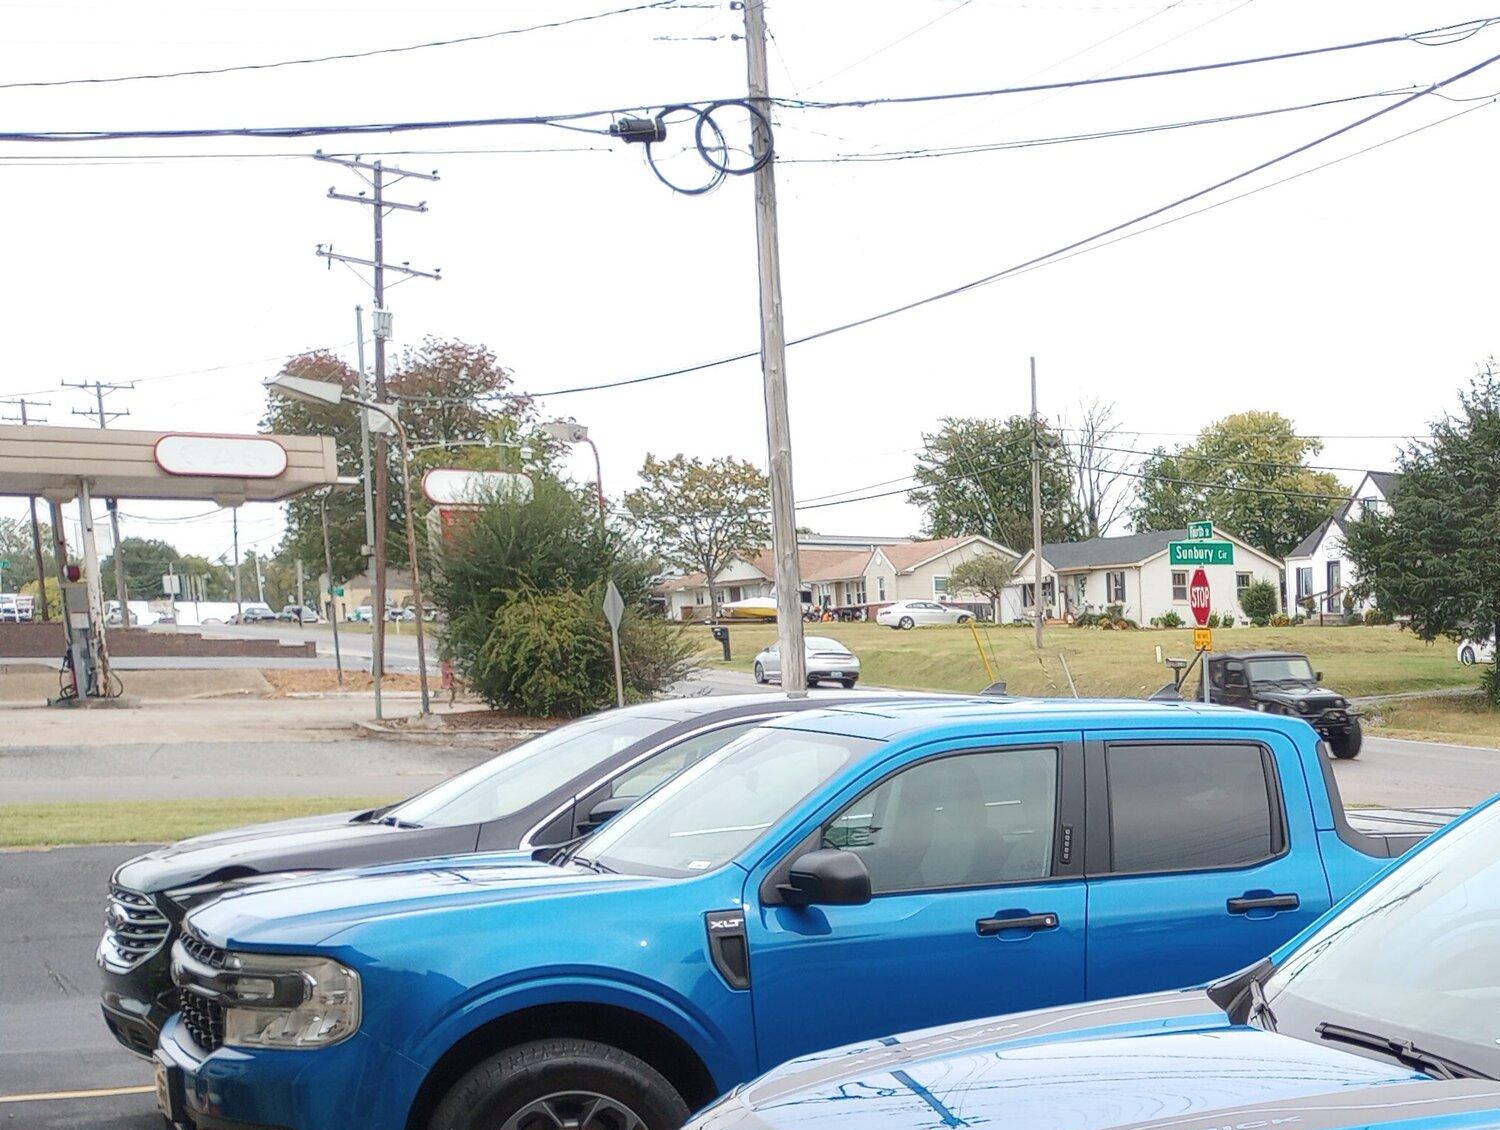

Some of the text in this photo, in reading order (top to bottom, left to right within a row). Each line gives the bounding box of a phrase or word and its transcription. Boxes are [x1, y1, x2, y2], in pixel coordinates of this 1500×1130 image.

[1176, 546, 1227, 562] Sunbury Cir
[1191, 586, 1210, 609] STOP
[710, 918, 744, 930] XLT
